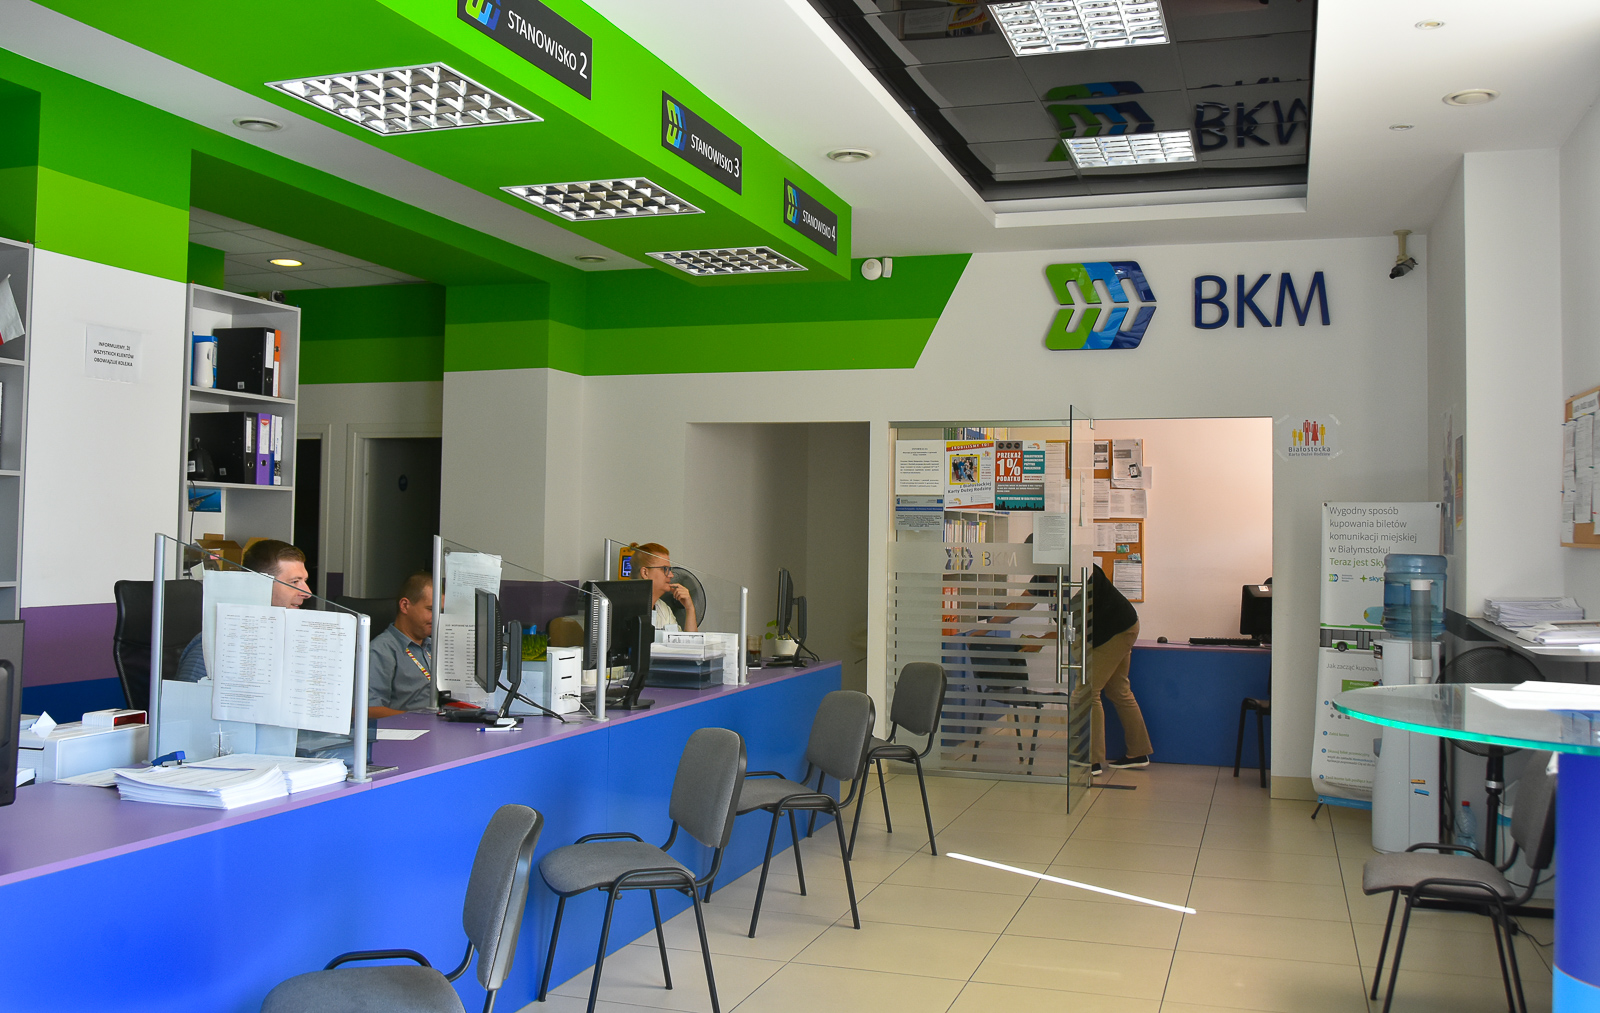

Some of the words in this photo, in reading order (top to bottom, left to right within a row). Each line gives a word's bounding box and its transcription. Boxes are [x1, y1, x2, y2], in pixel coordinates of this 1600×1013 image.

[508, 10, 577, 71] STANOWISKO
[580, 51, 588, 80] 2
[690, 133, 733, 174] STANOWISKO
[734, 157, 740, 178] 3
[802, 209, 831, 239] STANOWISKO
[831, 225, 836, 242] 4
[1193, 271, 1331, 330] BKM
[997, 458, 1021, 476] 1%
[1329, 506, 1367, 516] Wygodny
[1368, 506, 1399, 516] sposób
[1329, 519, 1374, 529] kupowania
[1376, 519, 1407, 528] biletów
[1329, 532, 1379, 543] komunikacji
[1381, 533, 1417, 543] miejskiej
[1338, 545, 1391, 555] Białymstoku!
[1329, 557, 1352, 566] Teraz
[1353, 558, 1369, 568] jest
